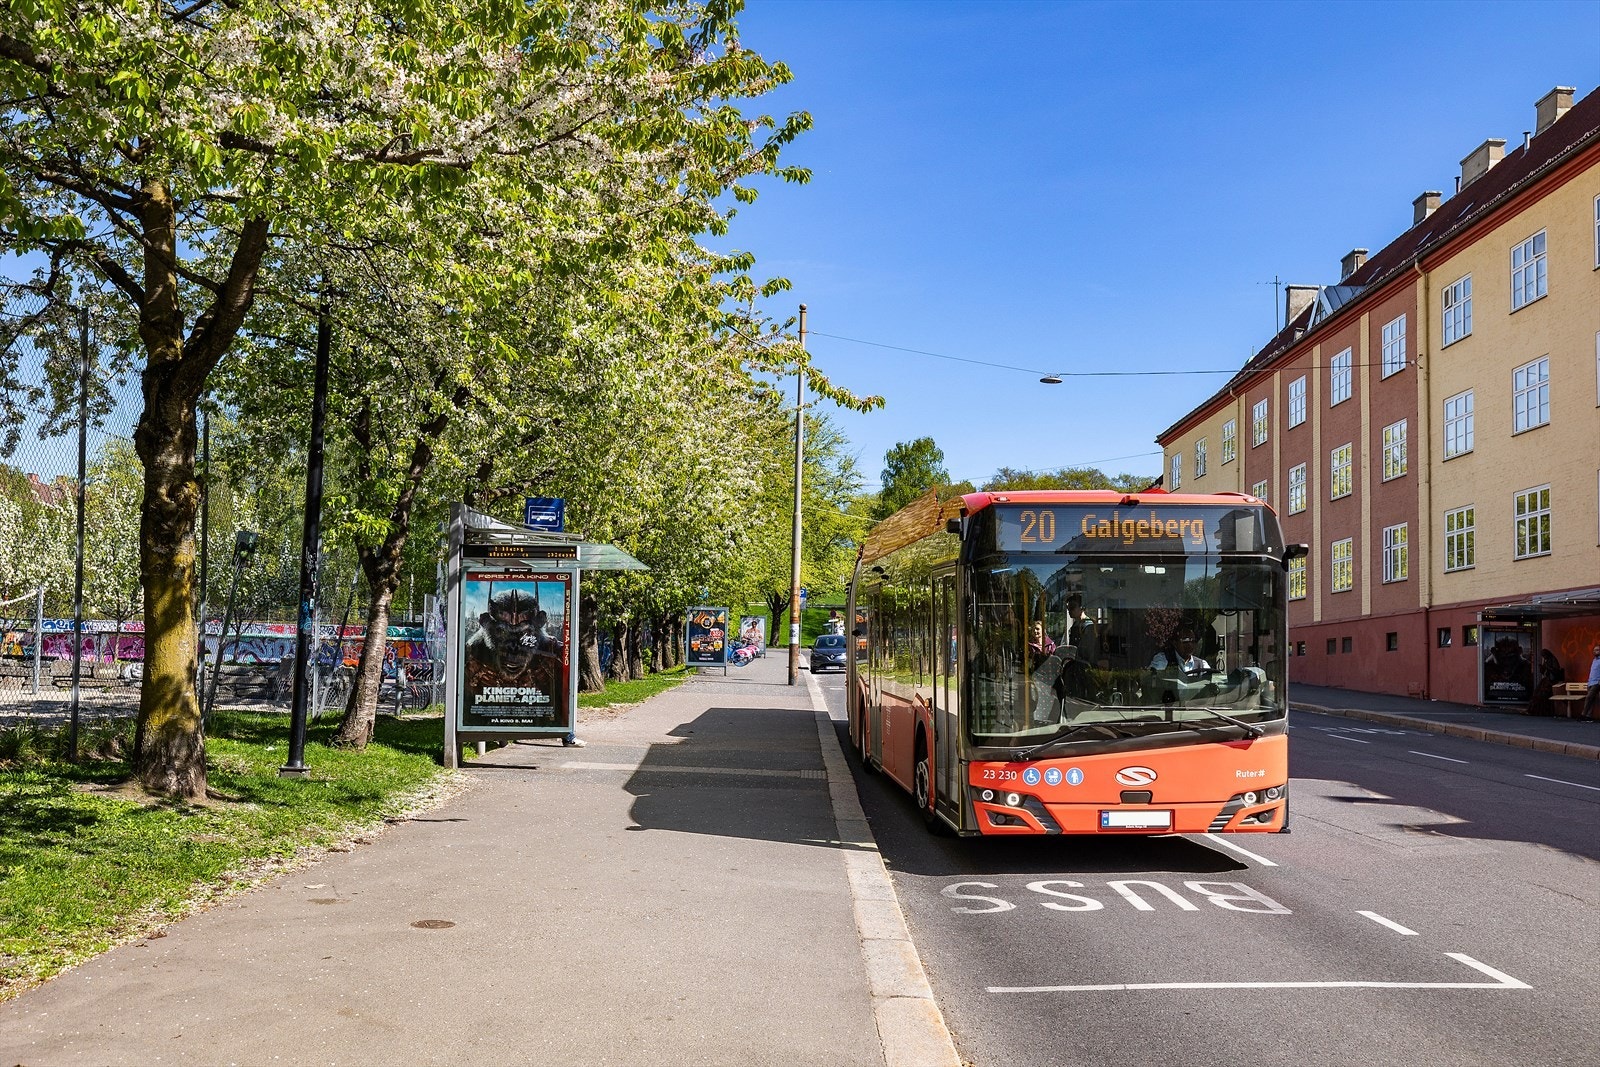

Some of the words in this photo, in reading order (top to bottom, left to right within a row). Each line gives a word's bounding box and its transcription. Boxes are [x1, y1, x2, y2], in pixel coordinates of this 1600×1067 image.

[1020, 510, 1055, 543] 20
[1081, 511, 1204, 545] Galgeberg
[483, 687, 535, 695] KINGDOM
[475, 695, 515, 704] PLANET
[521, 695, 550, 705] APES
[983, 769, 996, 779] 23
[998, 770, 1018, 780] 230
[940, 879, 1293, 915] BUSS
